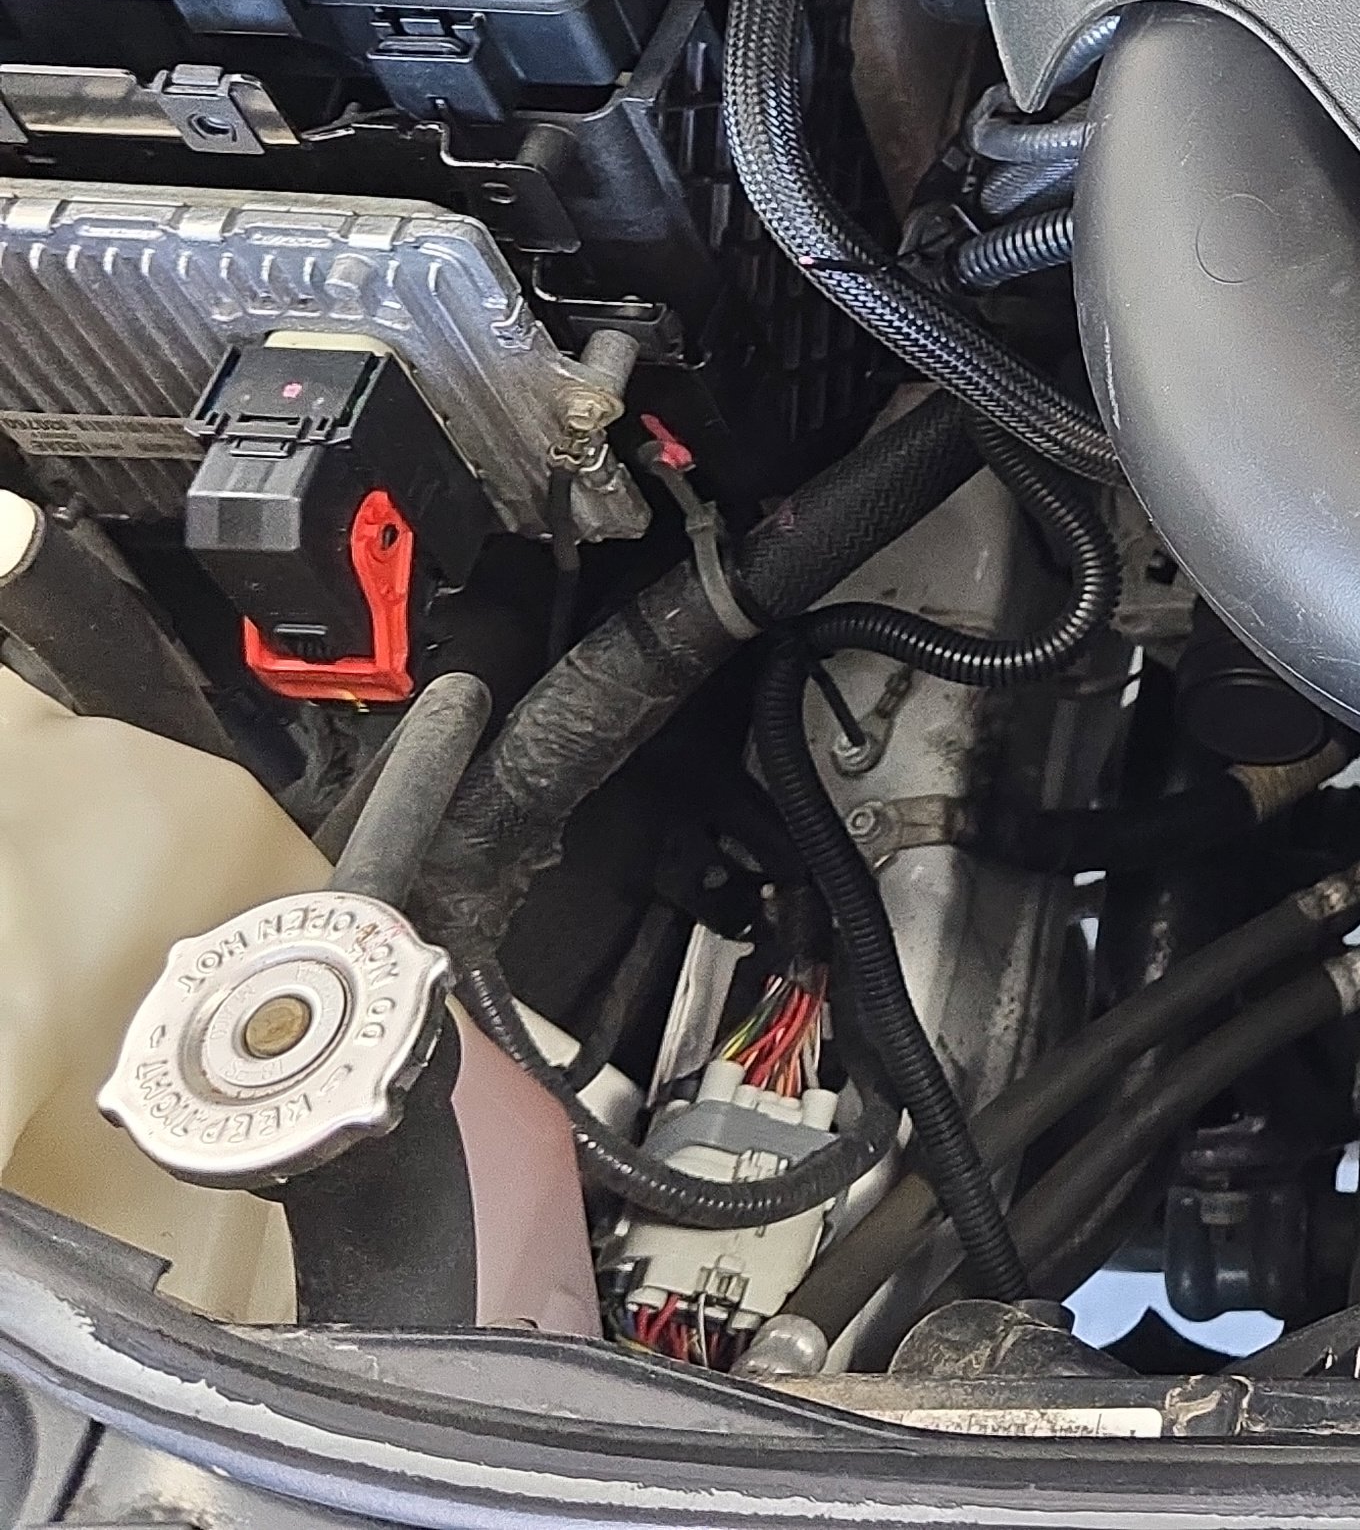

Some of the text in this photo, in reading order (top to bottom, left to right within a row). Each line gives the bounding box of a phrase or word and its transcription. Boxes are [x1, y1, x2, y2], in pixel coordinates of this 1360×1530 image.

[256, 907, 357, 943] OPEN
[178, 930, 247, 1001] HOT
[354, 997, 394, 1047] DO
[136, 1058, 312, 1145] KEEP TIGHT
